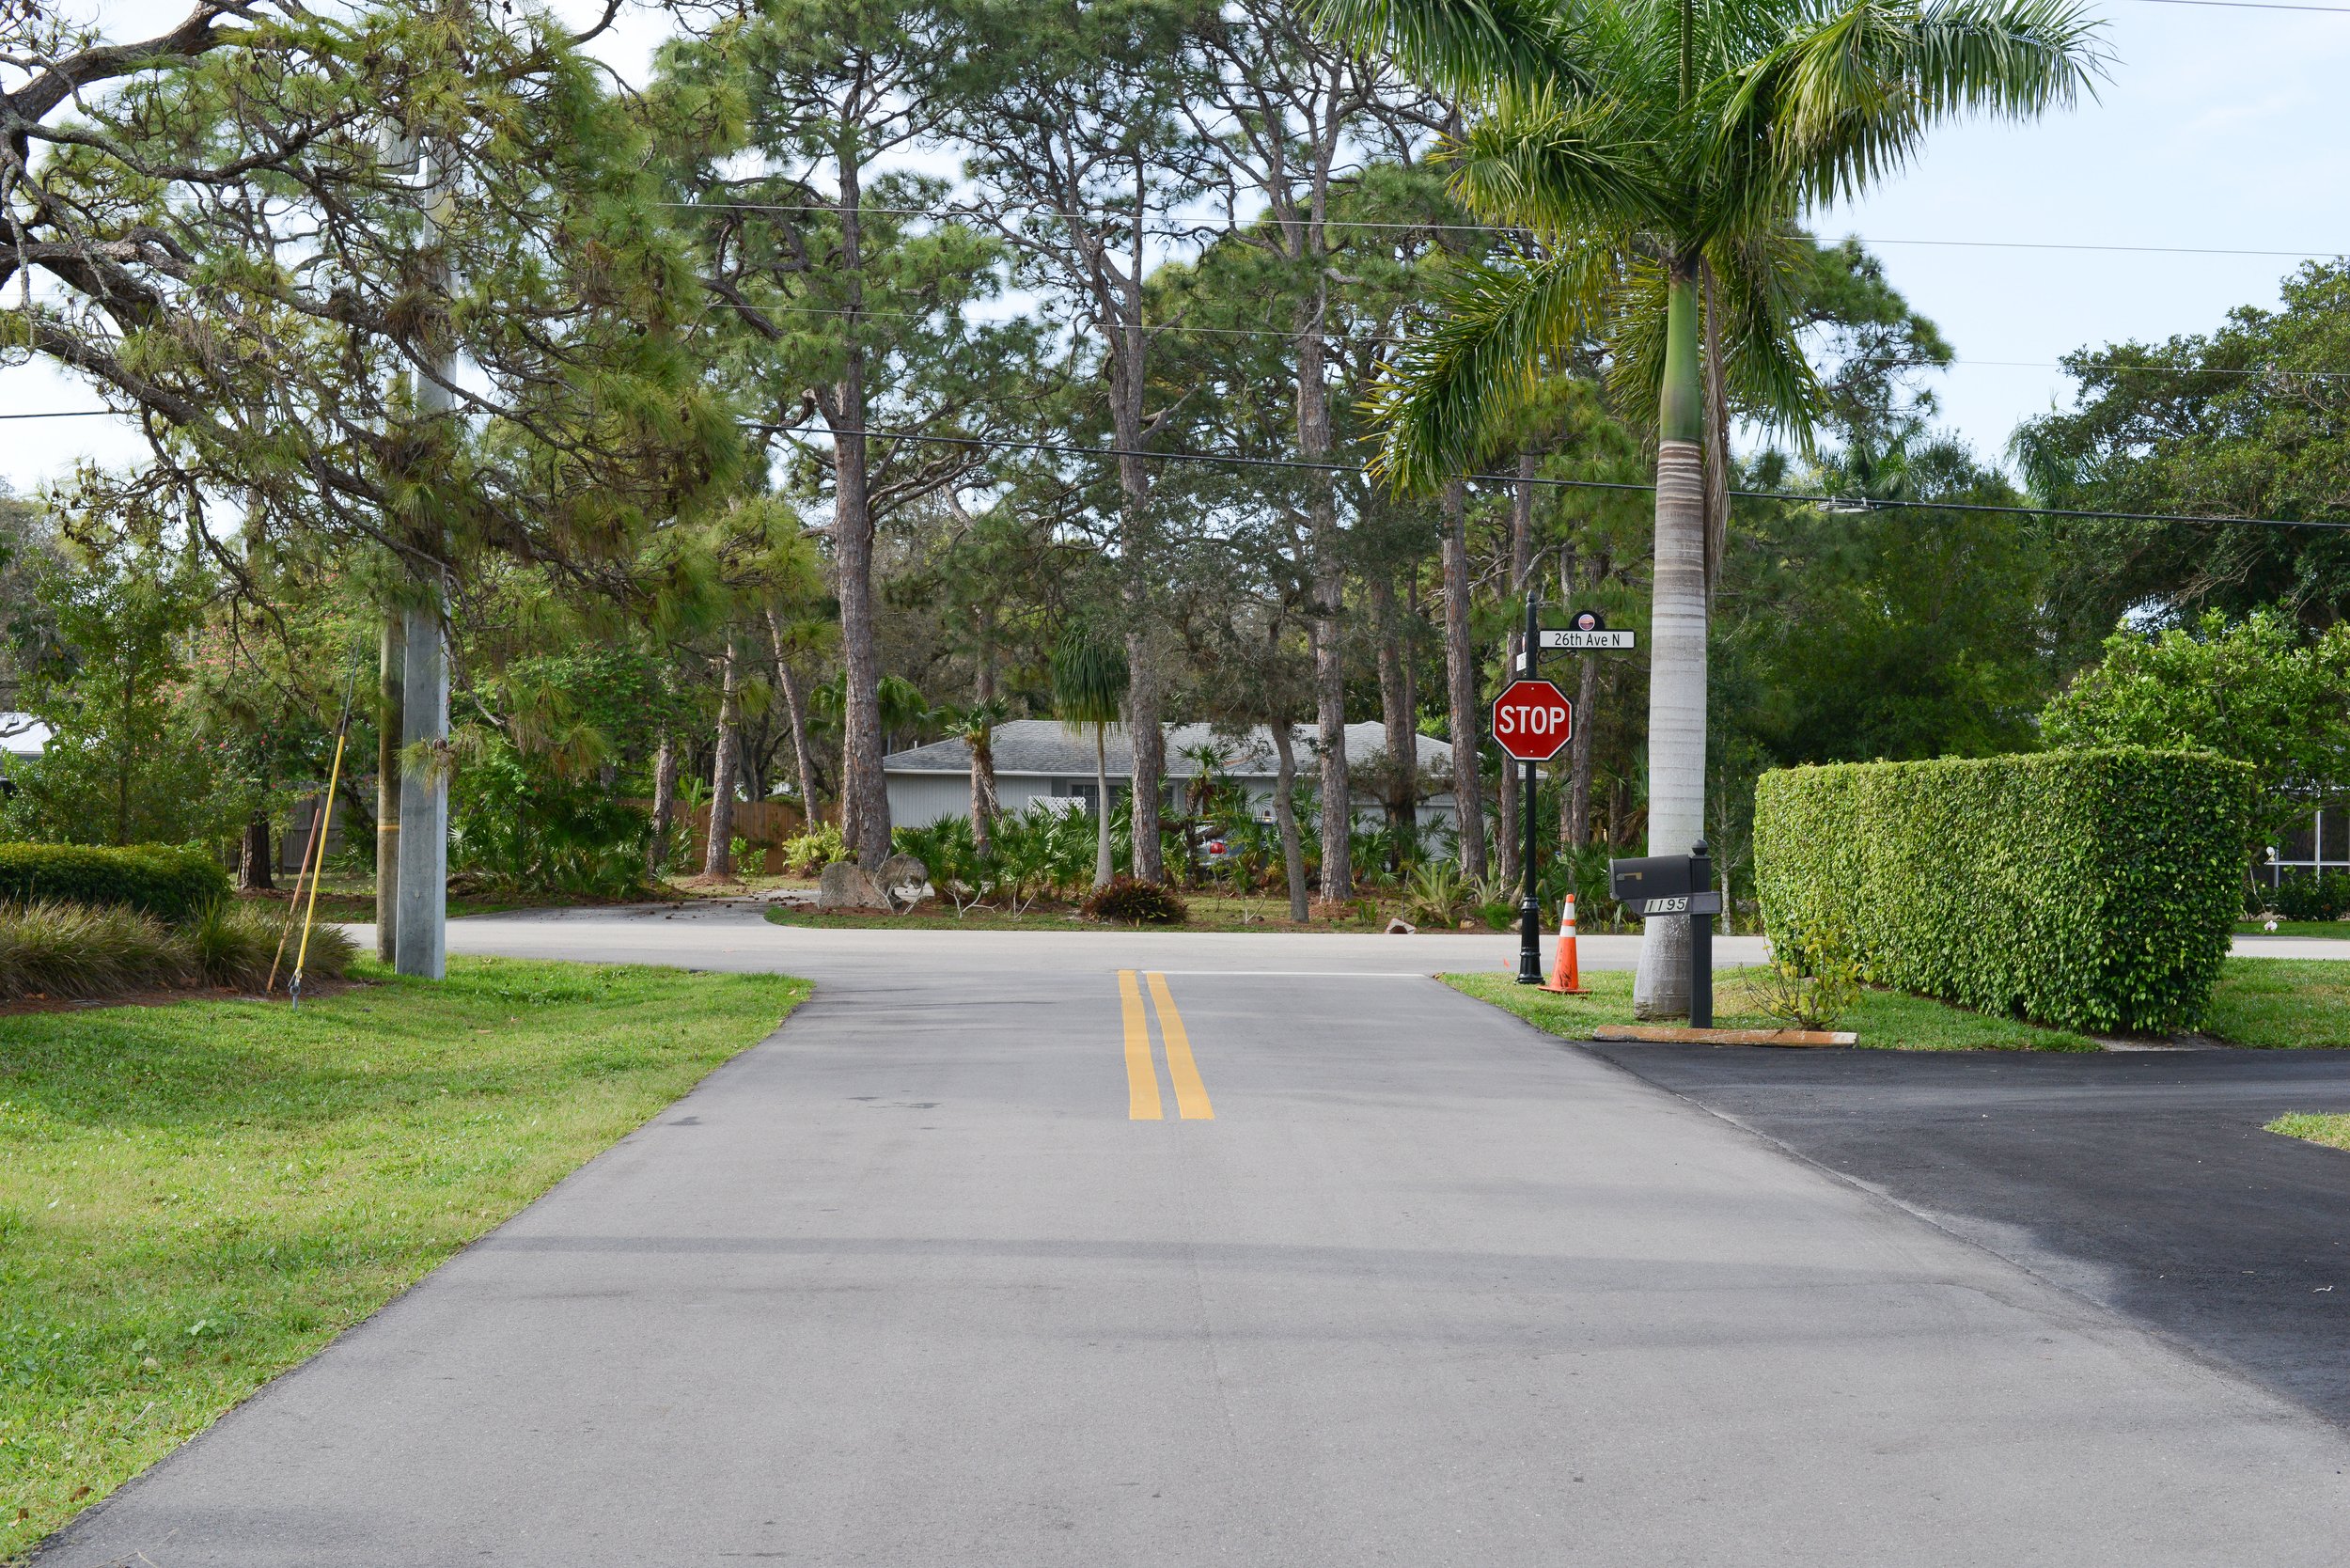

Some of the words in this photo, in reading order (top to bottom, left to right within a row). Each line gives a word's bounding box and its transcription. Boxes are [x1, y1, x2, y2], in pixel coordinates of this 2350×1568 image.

[1555, 633, 1582, 646] 26th
[1586, 634, 1608, 646] Ave
[1612, 634, 1621, 646] N
[1498, 705, 1566, 735] STOP
[1648, 898, 1685, 912] 1195
